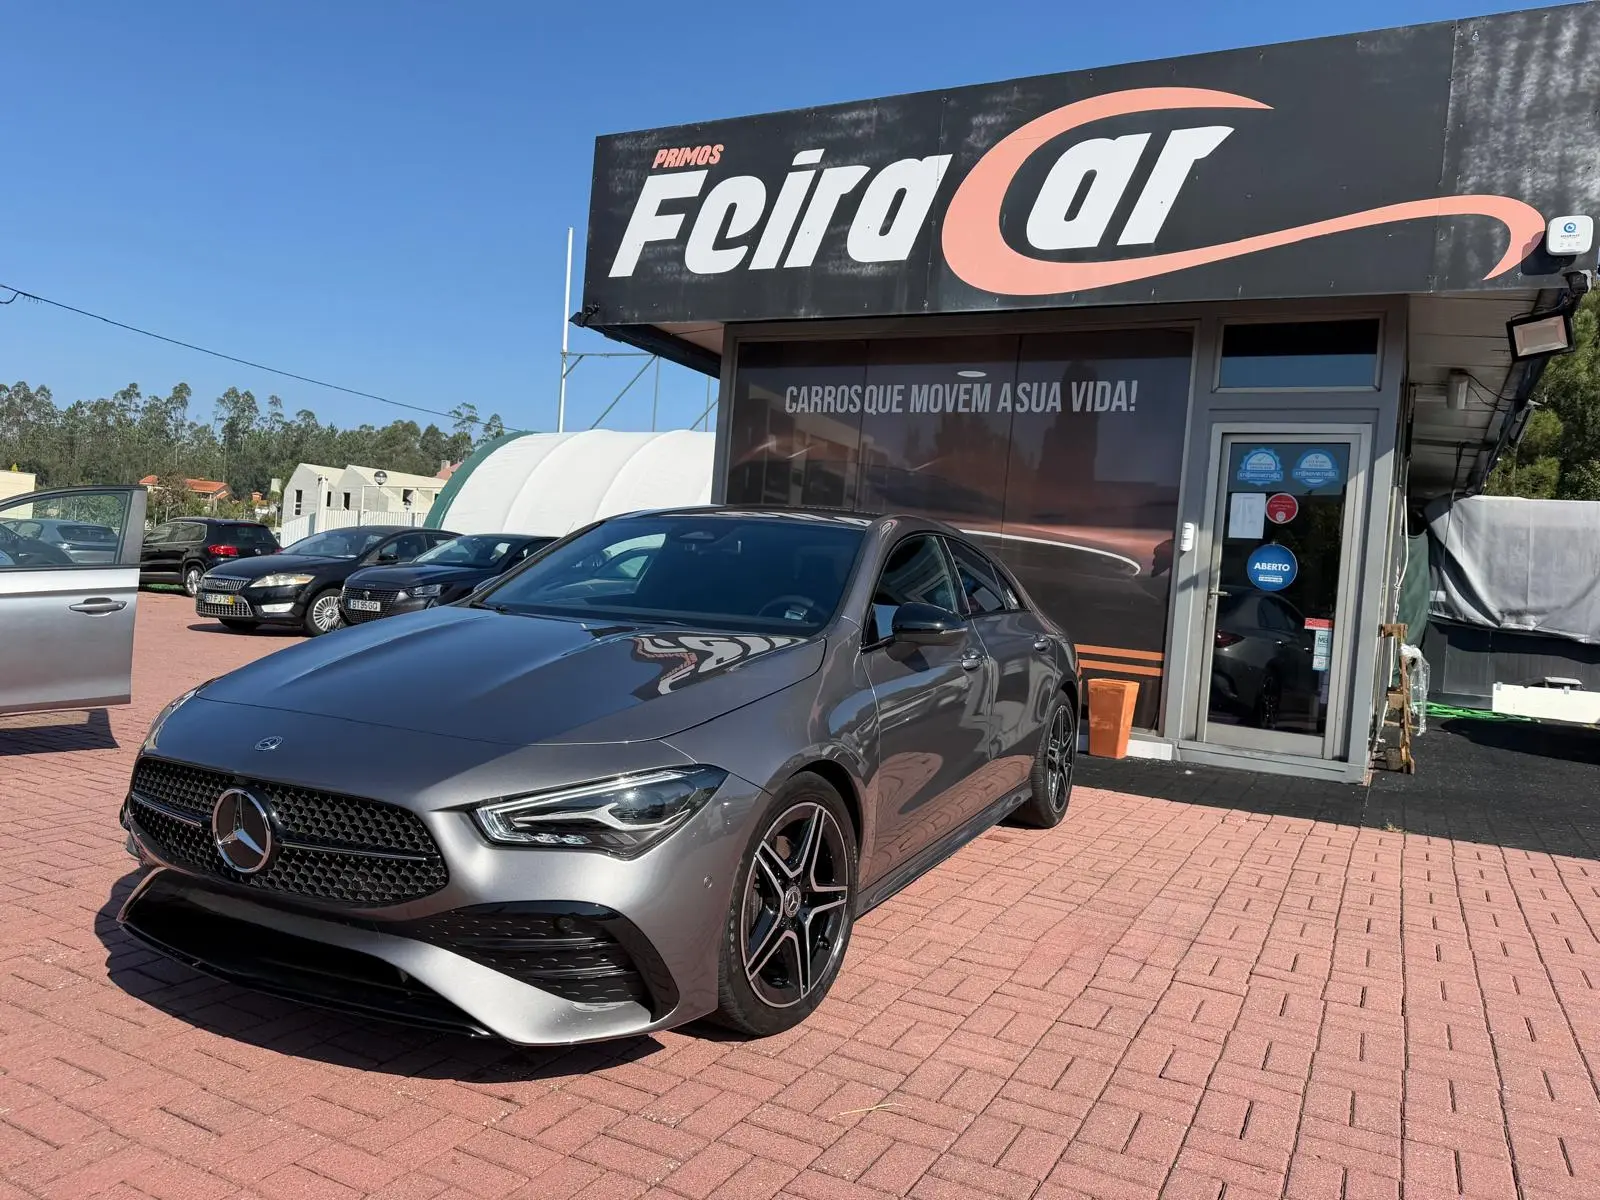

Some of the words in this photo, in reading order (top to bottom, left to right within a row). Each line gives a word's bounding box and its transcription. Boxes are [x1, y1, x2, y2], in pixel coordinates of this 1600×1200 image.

[652, 144, 724, 168] PRIMOS
[784, 385, 861, 414] CARROS
[863, 385, 905, 415] QUE
[909, 383, 992, 413] MOVEM
[997, 382, 1012, 412] A
[1015, 382, 1063, 412] SUA
[1071, 380, 1139, 412] VIDA!
[1253, 562, 1291, 572] ABERTO
